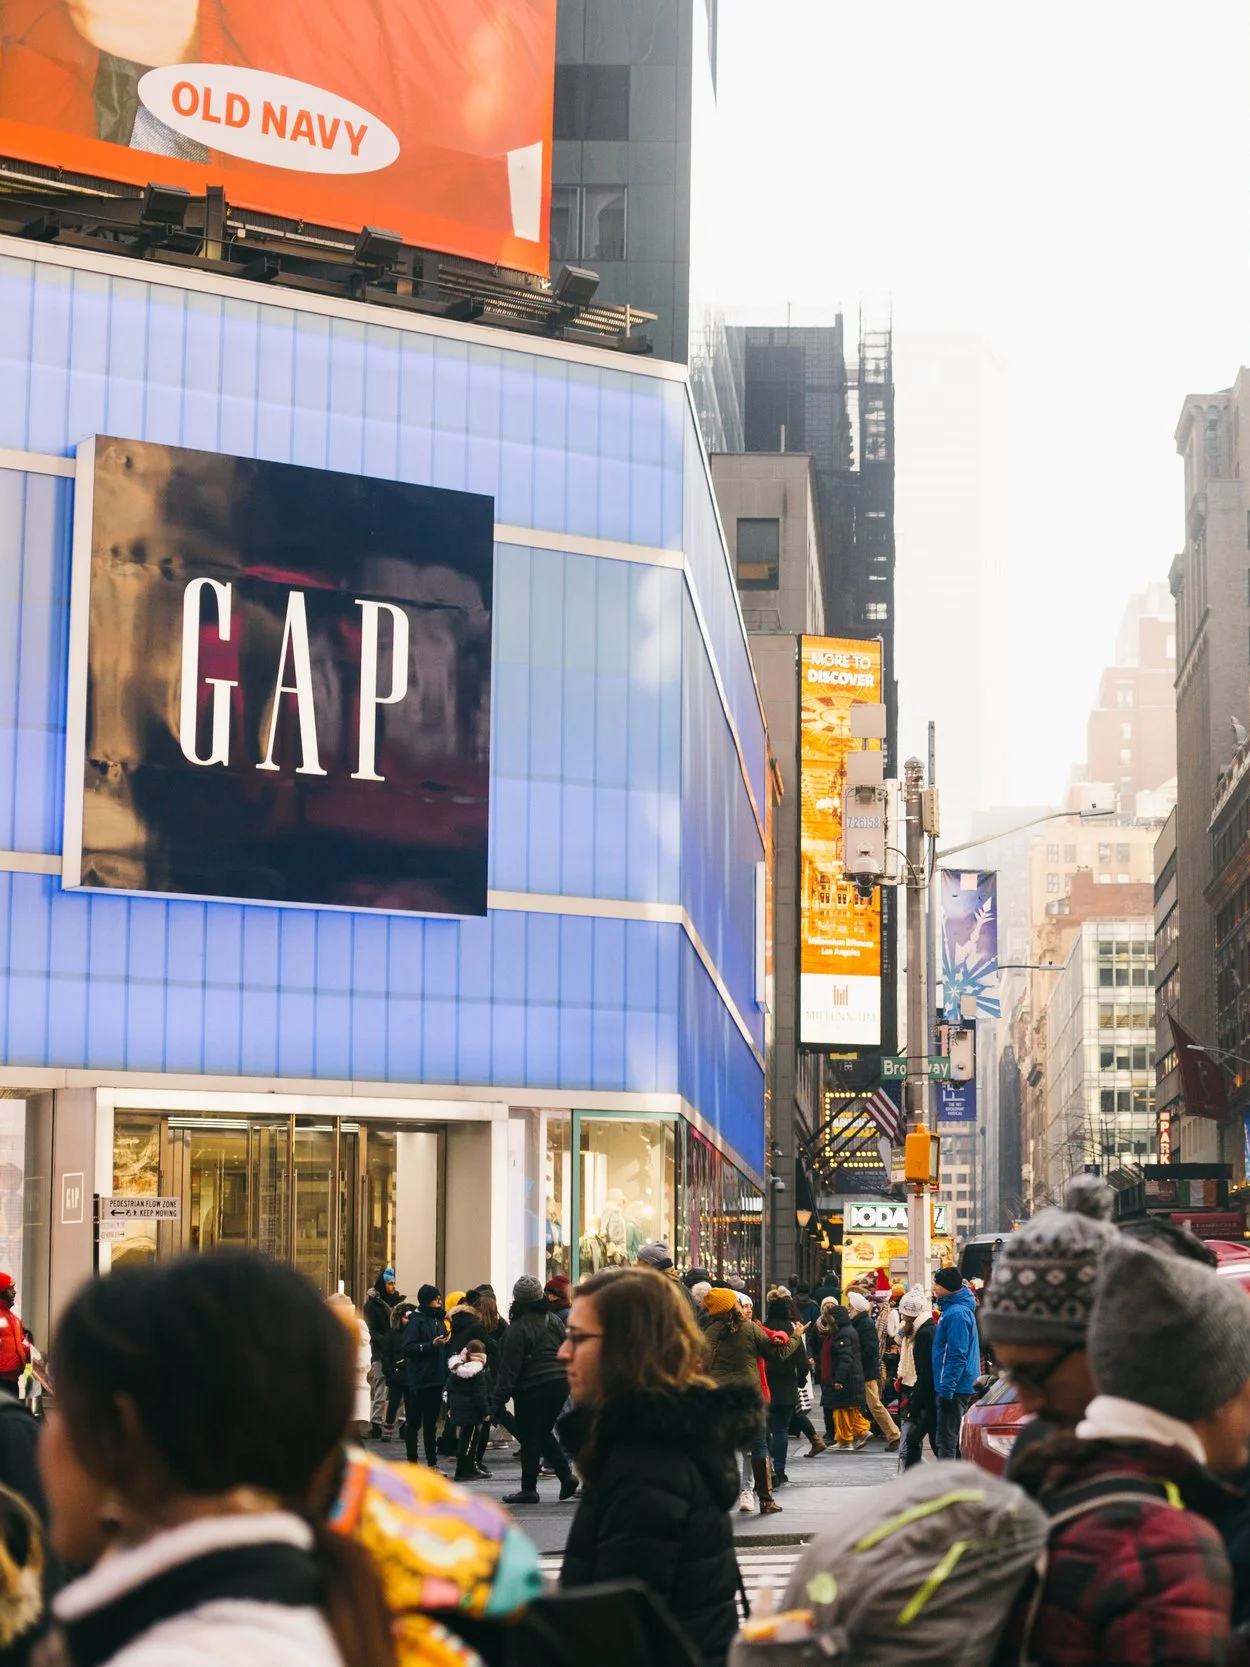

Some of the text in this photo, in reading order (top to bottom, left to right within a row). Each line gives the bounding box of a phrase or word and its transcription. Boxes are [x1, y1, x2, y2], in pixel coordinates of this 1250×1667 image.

[171, 80, 369, 158] OLD NAVY
[811, 651, 871, 670] MORE TO
[180, 577, 410, 781] GAP
[807, 669, 875, 687] DISCOVER
[848, 816, 880, 829] 726158
[1160, 1121, 1171, 1165] PARK
[66, 1187, 80, 1209] GAP
[110, 1199, 177, 1208] PEDESTRIAN FLOW ZONE
[139, 1209, 177, 1217] KEEP MOVING
